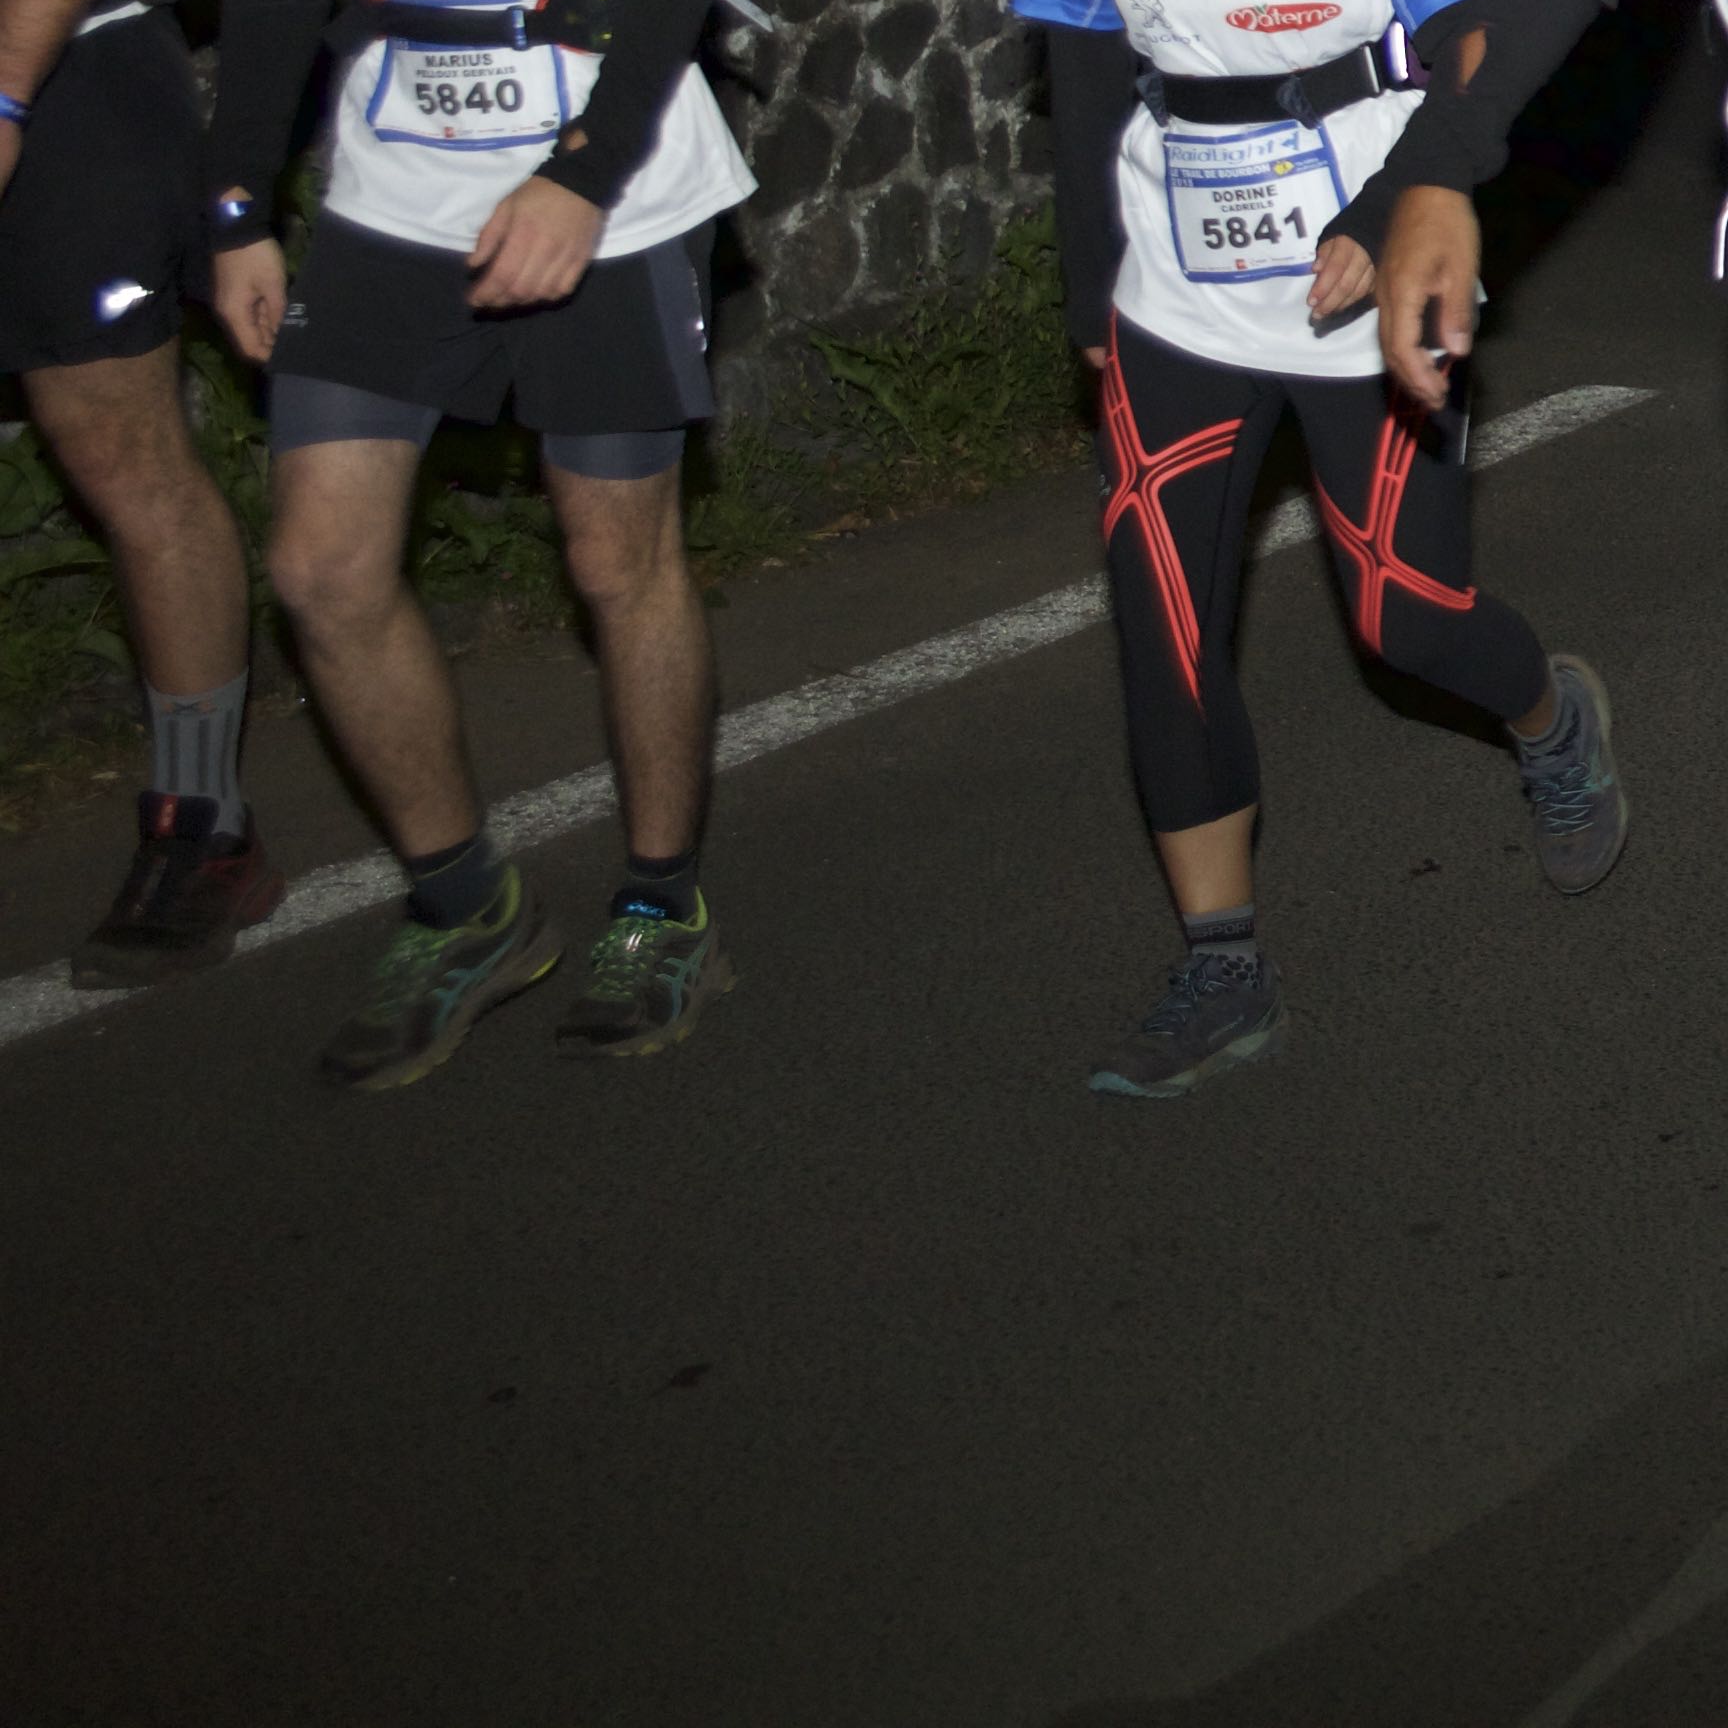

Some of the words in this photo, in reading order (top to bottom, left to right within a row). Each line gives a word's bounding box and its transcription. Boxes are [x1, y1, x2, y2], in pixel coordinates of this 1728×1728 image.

[1226, 3, 1339, 32] Materne
[425, 53, 494, 68] MARIUS
[415, 78, 525, 117] 5840
[1212, 184, 1279, 203] DORINE
[1202, 205, 1308, 250] 5841
